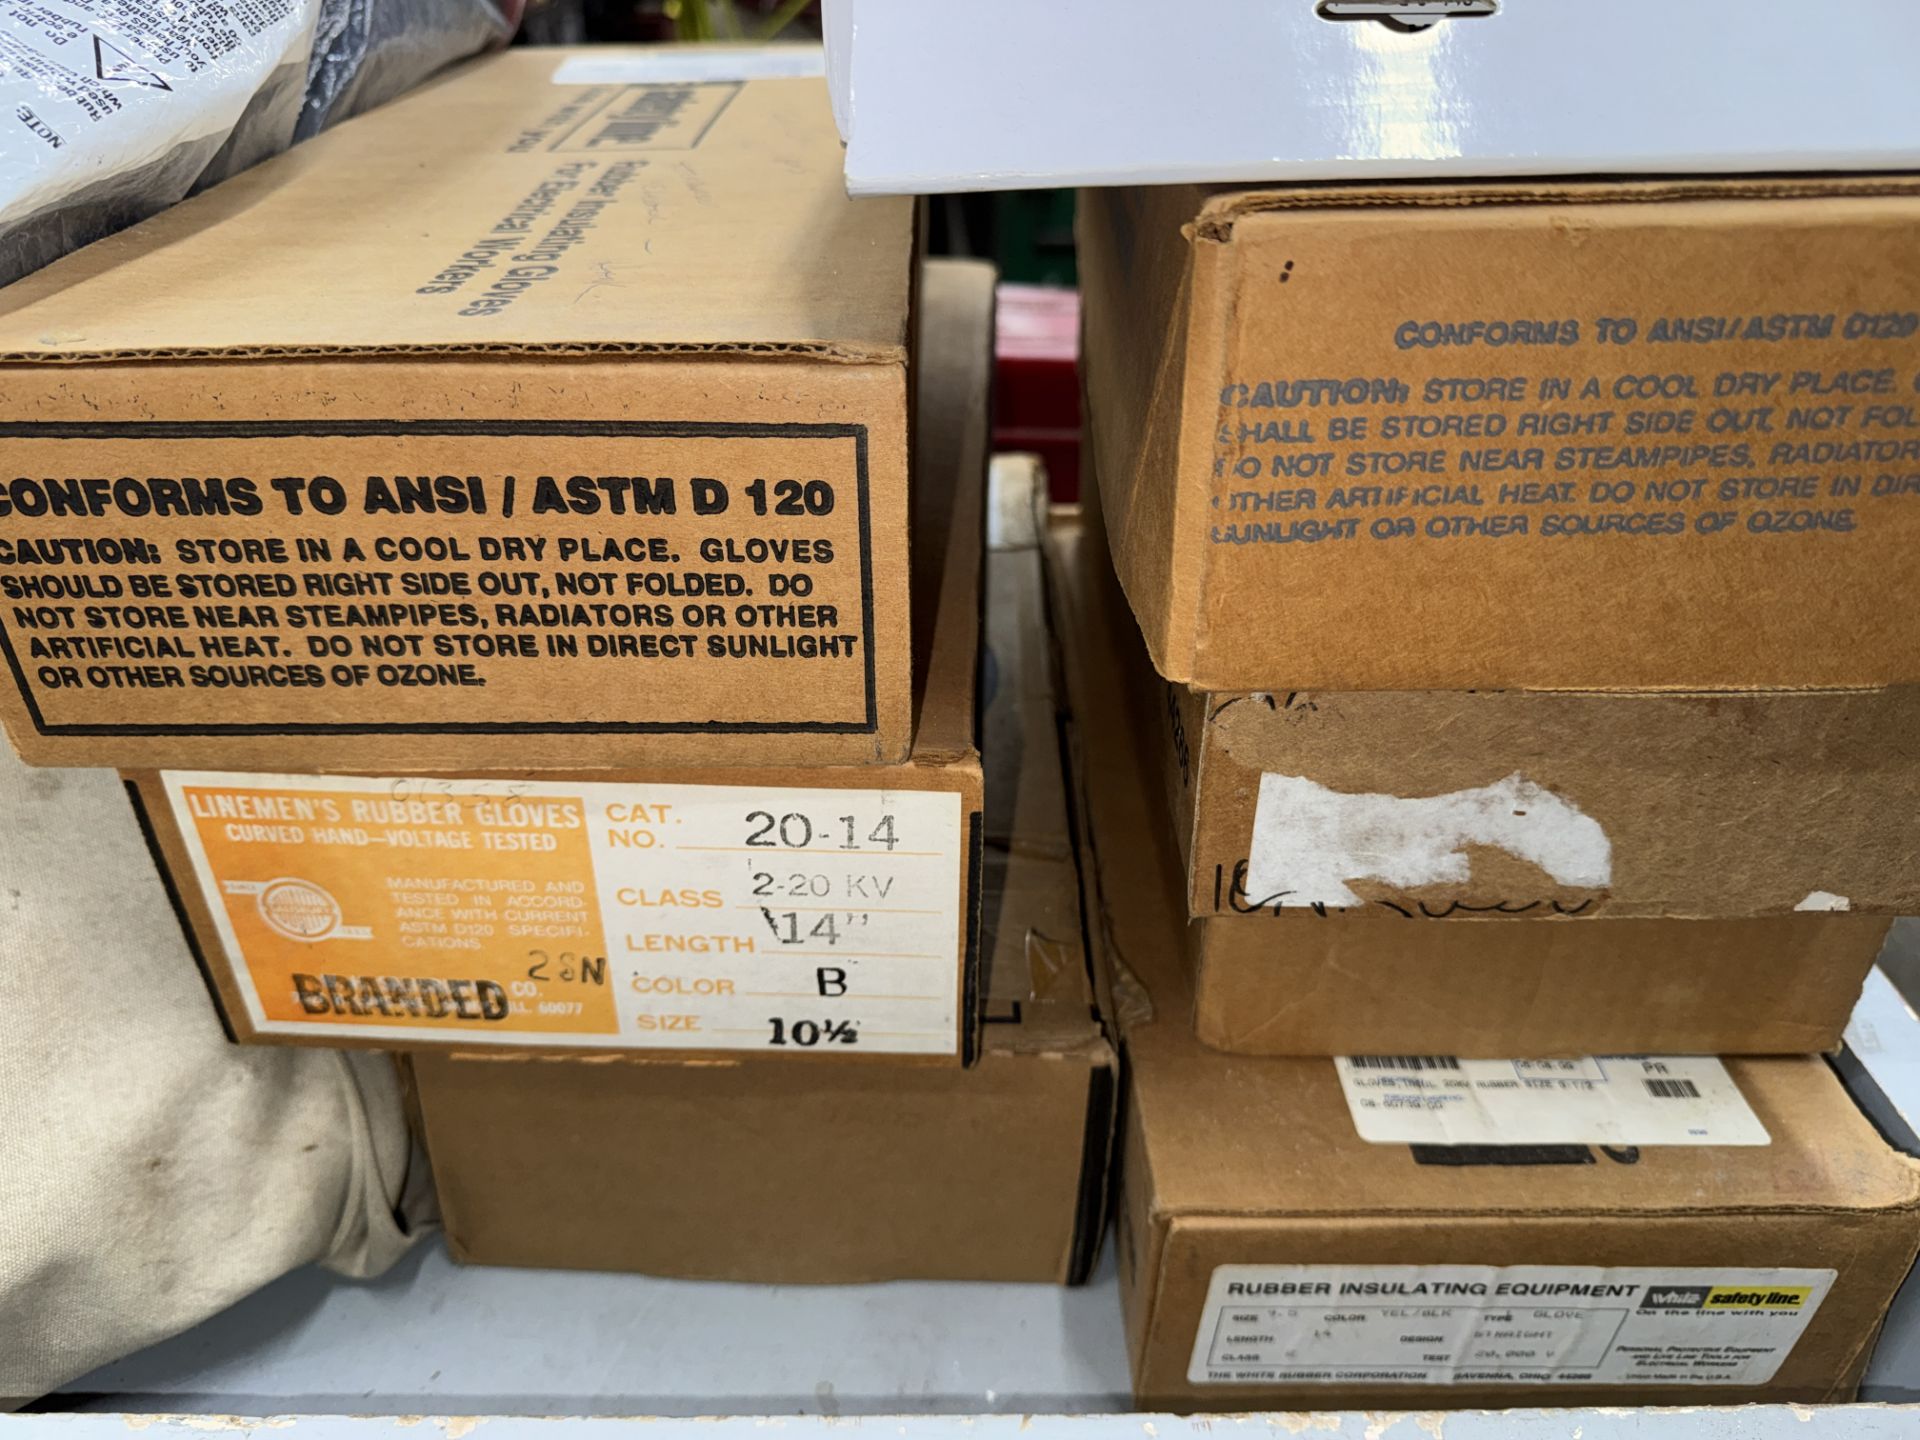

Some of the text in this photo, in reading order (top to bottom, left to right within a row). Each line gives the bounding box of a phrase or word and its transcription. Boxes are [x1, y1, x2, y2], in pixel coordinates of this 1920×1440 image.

[8, 10, 38, 28] not
[35, 7, 88, 33] rubber
[16, 105, 62, 149] NOTE:
[415, 237, 527, 295] Workers
[457, 265, 560, 317] Gloves
[1395, 318, 1579, 349] CONFORMS
[1596, 317, 1638, 345] TO
[1219, 372, 1781, 409] CAUTION: STORE IN A COOL DRY
[1328, 416, 1368, 442] BE
[1380, 413, 1507, 440] STORED
[1517, 410, 1616, 437] RIGHT
[1624, 409, 1697, 435] SIDE
[1786, 406, 1855, 430] NOT
[1272, 453, 1334, 477] NOT
[1346, 450, 1446, 476] STORE
[1459, 448, 1545, 473] NEAR
[271, 477, 347, 515] TO
[363, 476, 487, 514] ANSI
[502, 476, 515, 518] /
[533, 476, 676, 516] ASTM
[691, 478, 729, 516] D
[746, 479, 835, 516] 120
[1326, 484, 1485, 510] ARTIFICIAL
[1589, 480, 1636, 505] DO
[1645, 478, 1708, 503] NOT
[1718, 475, 1820, 503] STORE
[1829, 473, 1861, 498] IN
[1369, 516, 1416, 540] OR
[1425, 515, 1529, 539] OTHER
[1539, 511, 1686, 537] SOURCES
[1694, 510, 1739, 535] OF
[0, 537, 834, 565] CAUTION: STORE IN A COOL DRY PLACE. GLOVES
[1, 572, 813, 599] SHOULD BE STORED RIGHT SIDE OUT, NOT FOLDED. DO
[13, 604, 838, 629] NOT STORE NEAR STEAMPIPES, RADIATORS OR OTHER
[30, 634, 858, 659] ARTIFICIAL HEAT. DO NOT STORE IN DIRECT SUNLIGHT
[38, 664, 486, 688] OR OTHER SOURCES OF OZONE.
[189, 794, 581, 829] LINEMEN'S RUBBER GLOVES
[605, 803, 682, 824] CAT.
[224, 823, 558, 851] CURVED TESTED
[608, 810, 899, 851] NO. 20-14
[385, 877, 585, 894] MANUFACTURED AND
[391, 892, 460, 905] TESTED
[472, 895, 493, 906] IN
[616, 872, 895, 908] CLASS 2-20 KV
[395, 907, 589, 923] ANCE WITH CURRENT
[399, 921, 448, 934] ASTM
[626, 934, 755, 953] LENGTH
[631, 967, 848, 997] COLOR B
[292, 973, 509, 1022] BRANDED
[637, 1014, 702, 1031] SIZE
[1228, 1282, 1640, 1298] RUBBER INSULATING EQUIPMENT
[1665, 1308, 1689, 1316] the
[1731, 1308, 1764, 1316] with
[1770, 1309, 1798, 1317] you
[1335, 1371, 1428, 1380] CORPORATION
